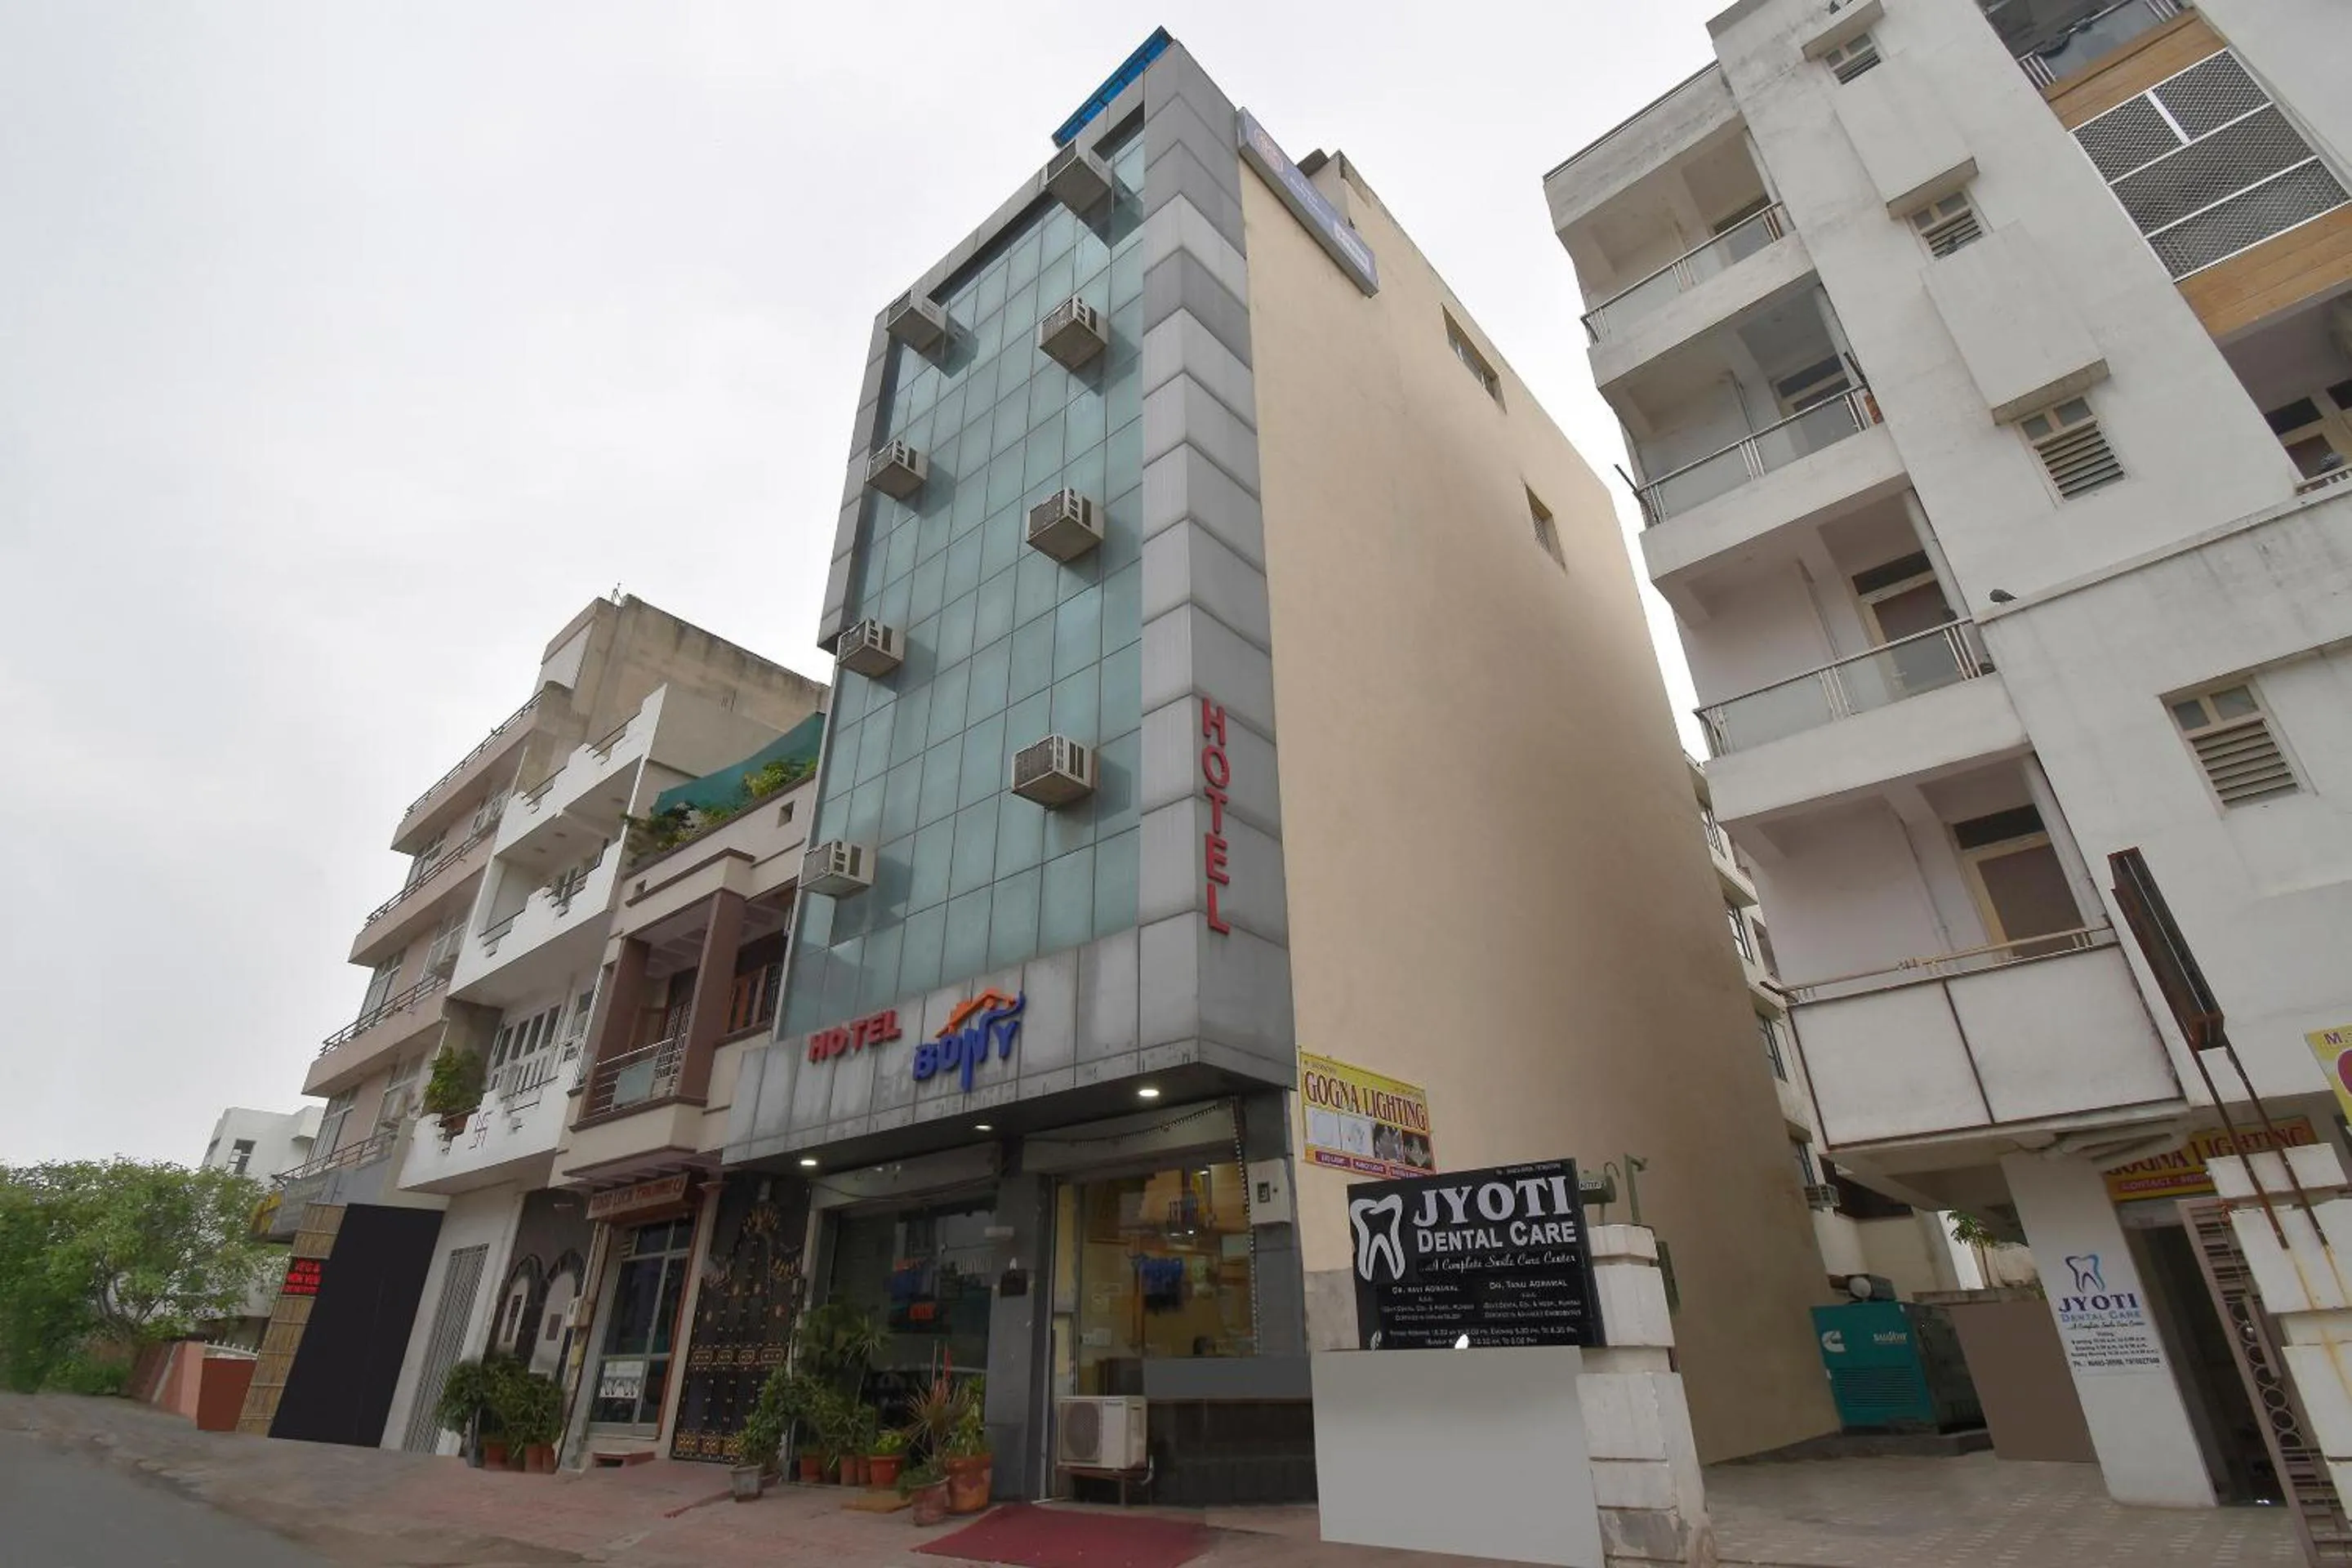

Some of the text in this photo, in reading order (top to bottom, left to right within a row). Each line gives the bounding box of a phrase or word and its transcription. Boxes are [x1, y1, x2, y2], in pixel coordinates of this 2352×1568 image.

[1201, 697, 1230, 935] HOTEL
[808, 1009, 902, 1063] HOTEL
[1305, 1070, 1427, 1131] GOGNA LIGHTING
[1413, 1176, 1571, 1227] JYOTI
[1417, 1221, 1577, 1254] DENTAL CARE
[2058, 1293, 2139, 1313] JYOTI
